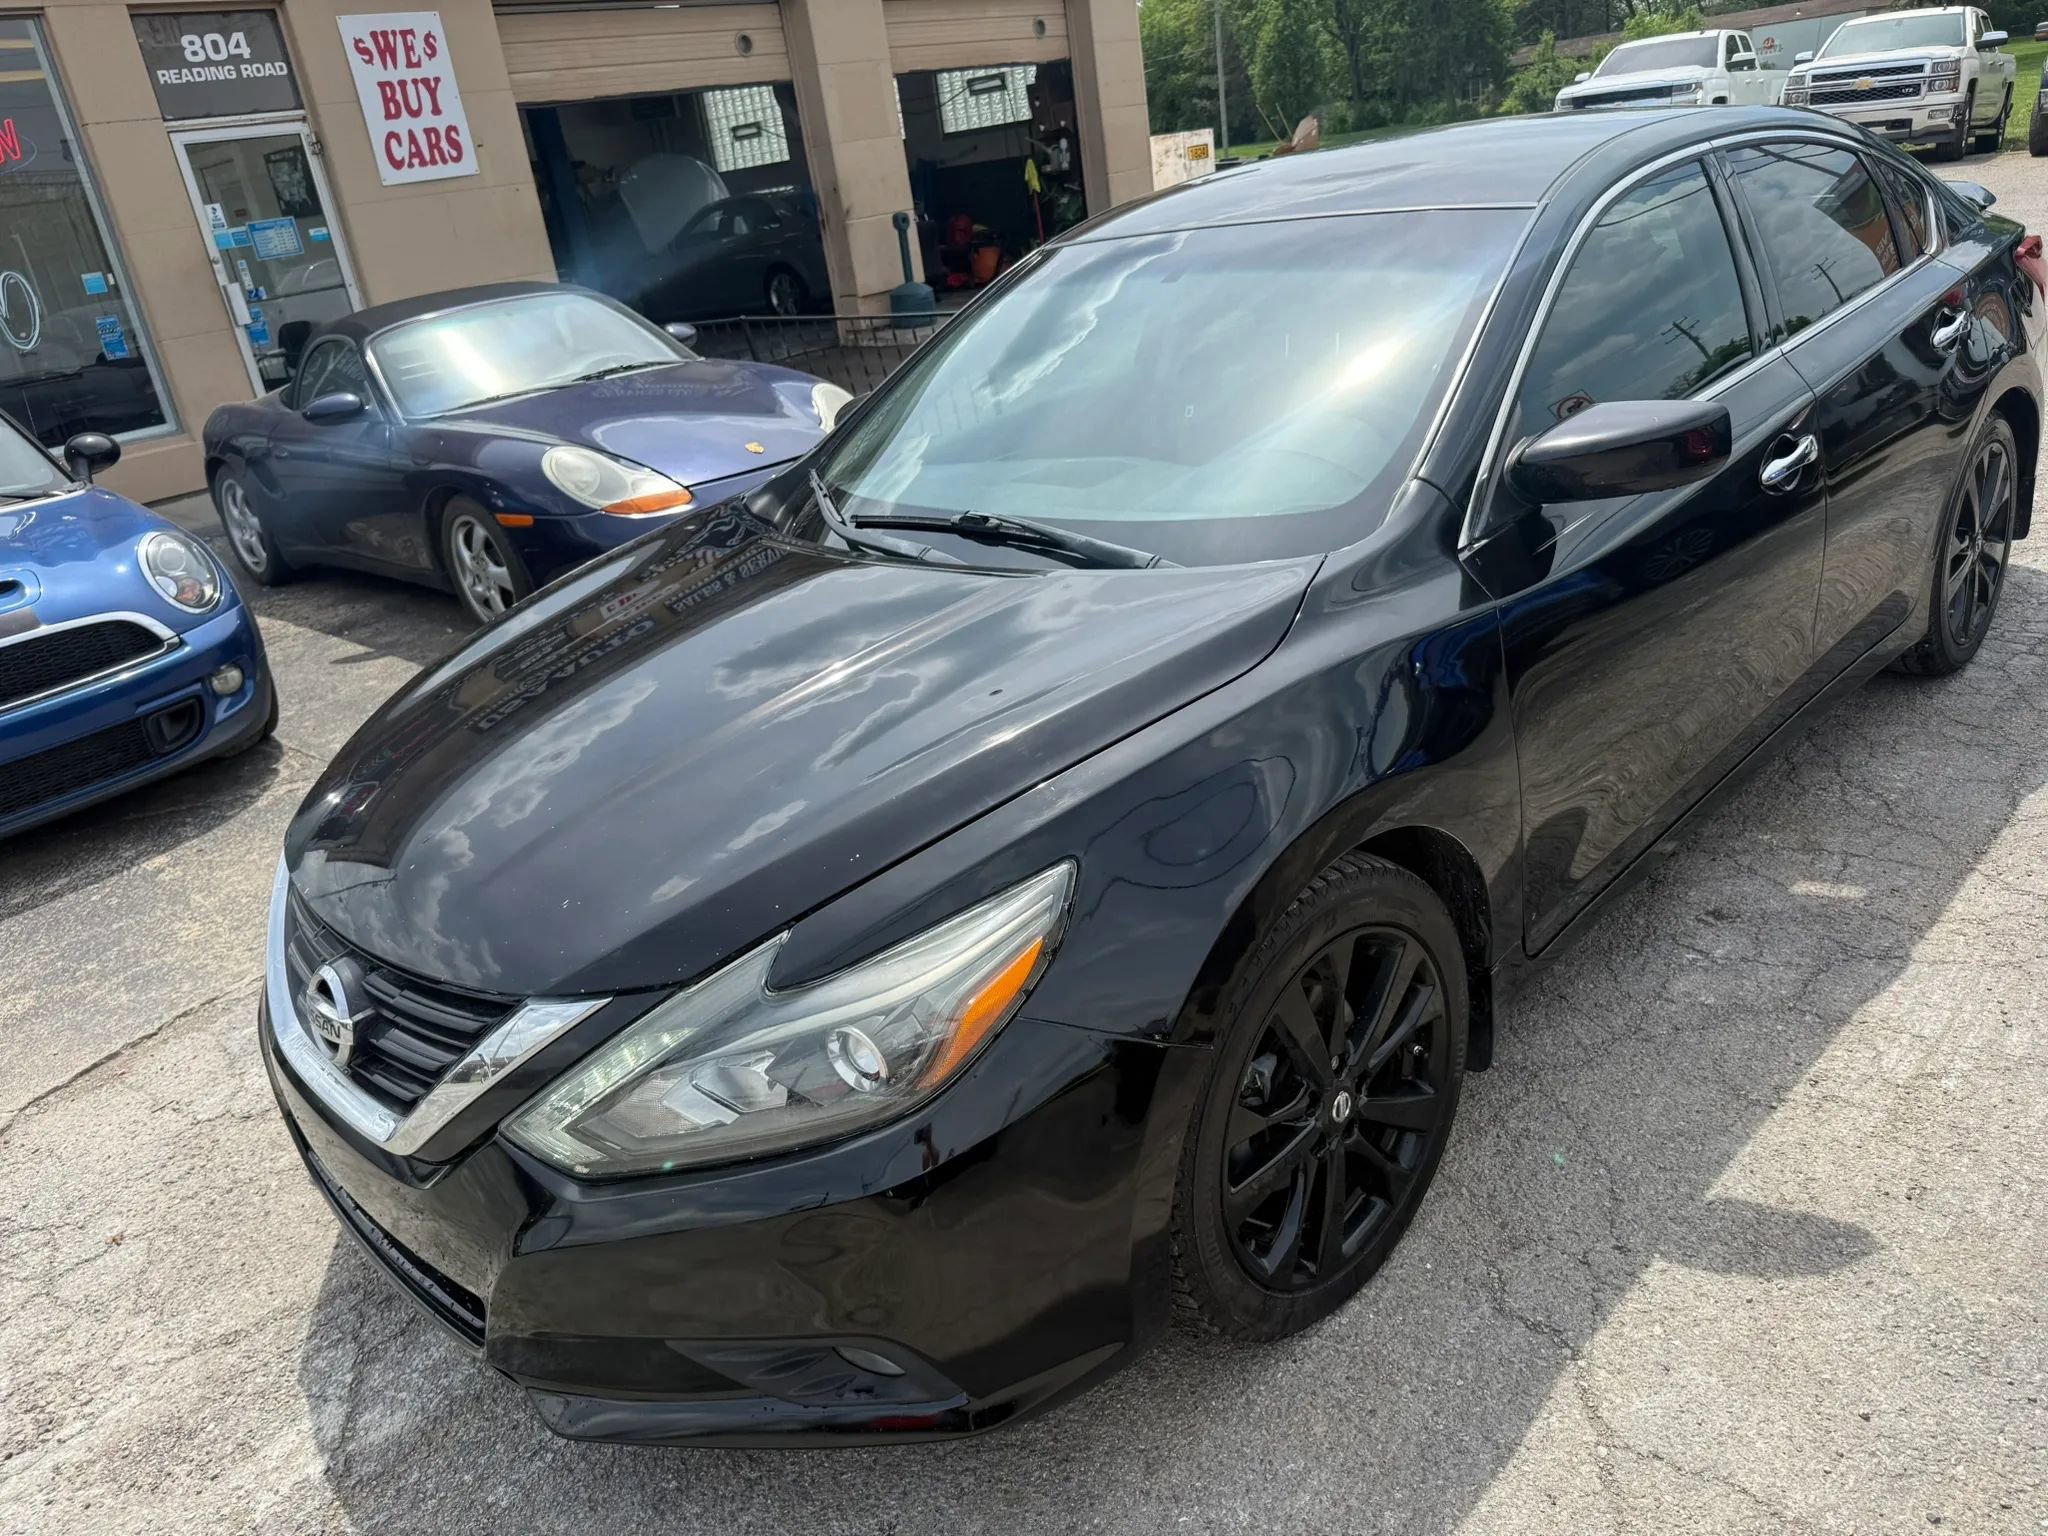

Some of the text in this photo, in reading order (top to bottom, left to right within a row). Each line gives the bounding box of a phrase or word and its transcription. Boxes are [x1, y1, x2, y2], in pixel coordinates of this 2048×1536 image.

[181, 31, 251, 63] 804
[157, 61, 288, 85] READING ROAD
[377, 76, 442, 121] BUY
[384, 124, 463, 170] CARS
